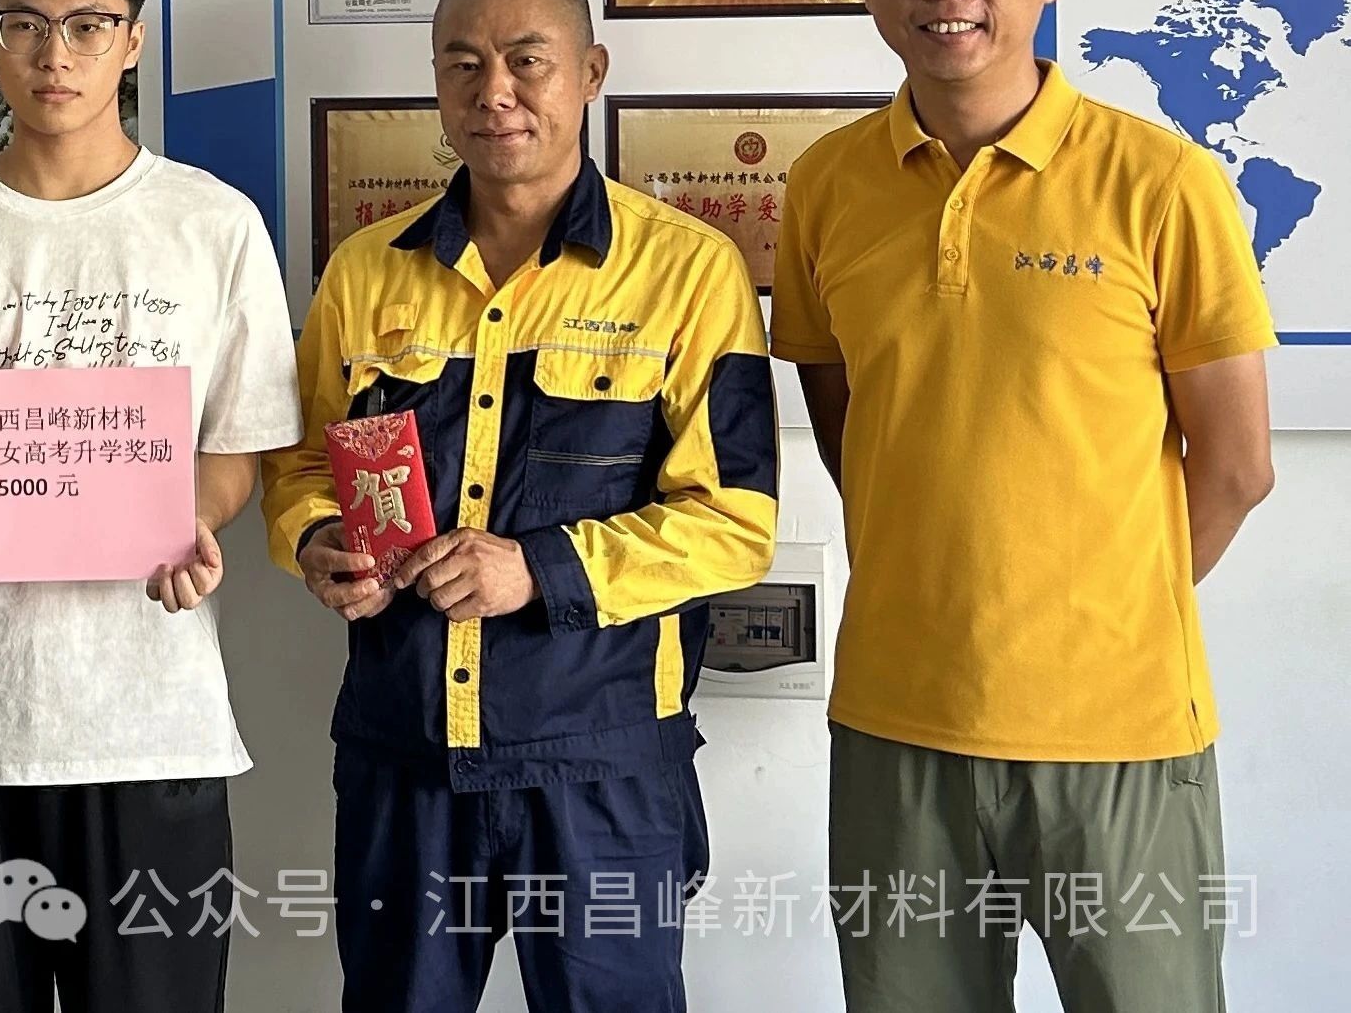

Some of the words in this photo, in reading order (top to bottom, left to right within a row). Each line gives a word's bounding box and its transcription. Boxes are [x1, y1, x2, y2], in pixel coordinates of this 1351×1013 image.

[643, 171, 787, 185] 江西昌峰新材料有限公司
[1014, 251, 1105, 282] 江西昌峰
[563, 317, 640, 333] 江西昌峰
[55, 473, 79, 498] 元
